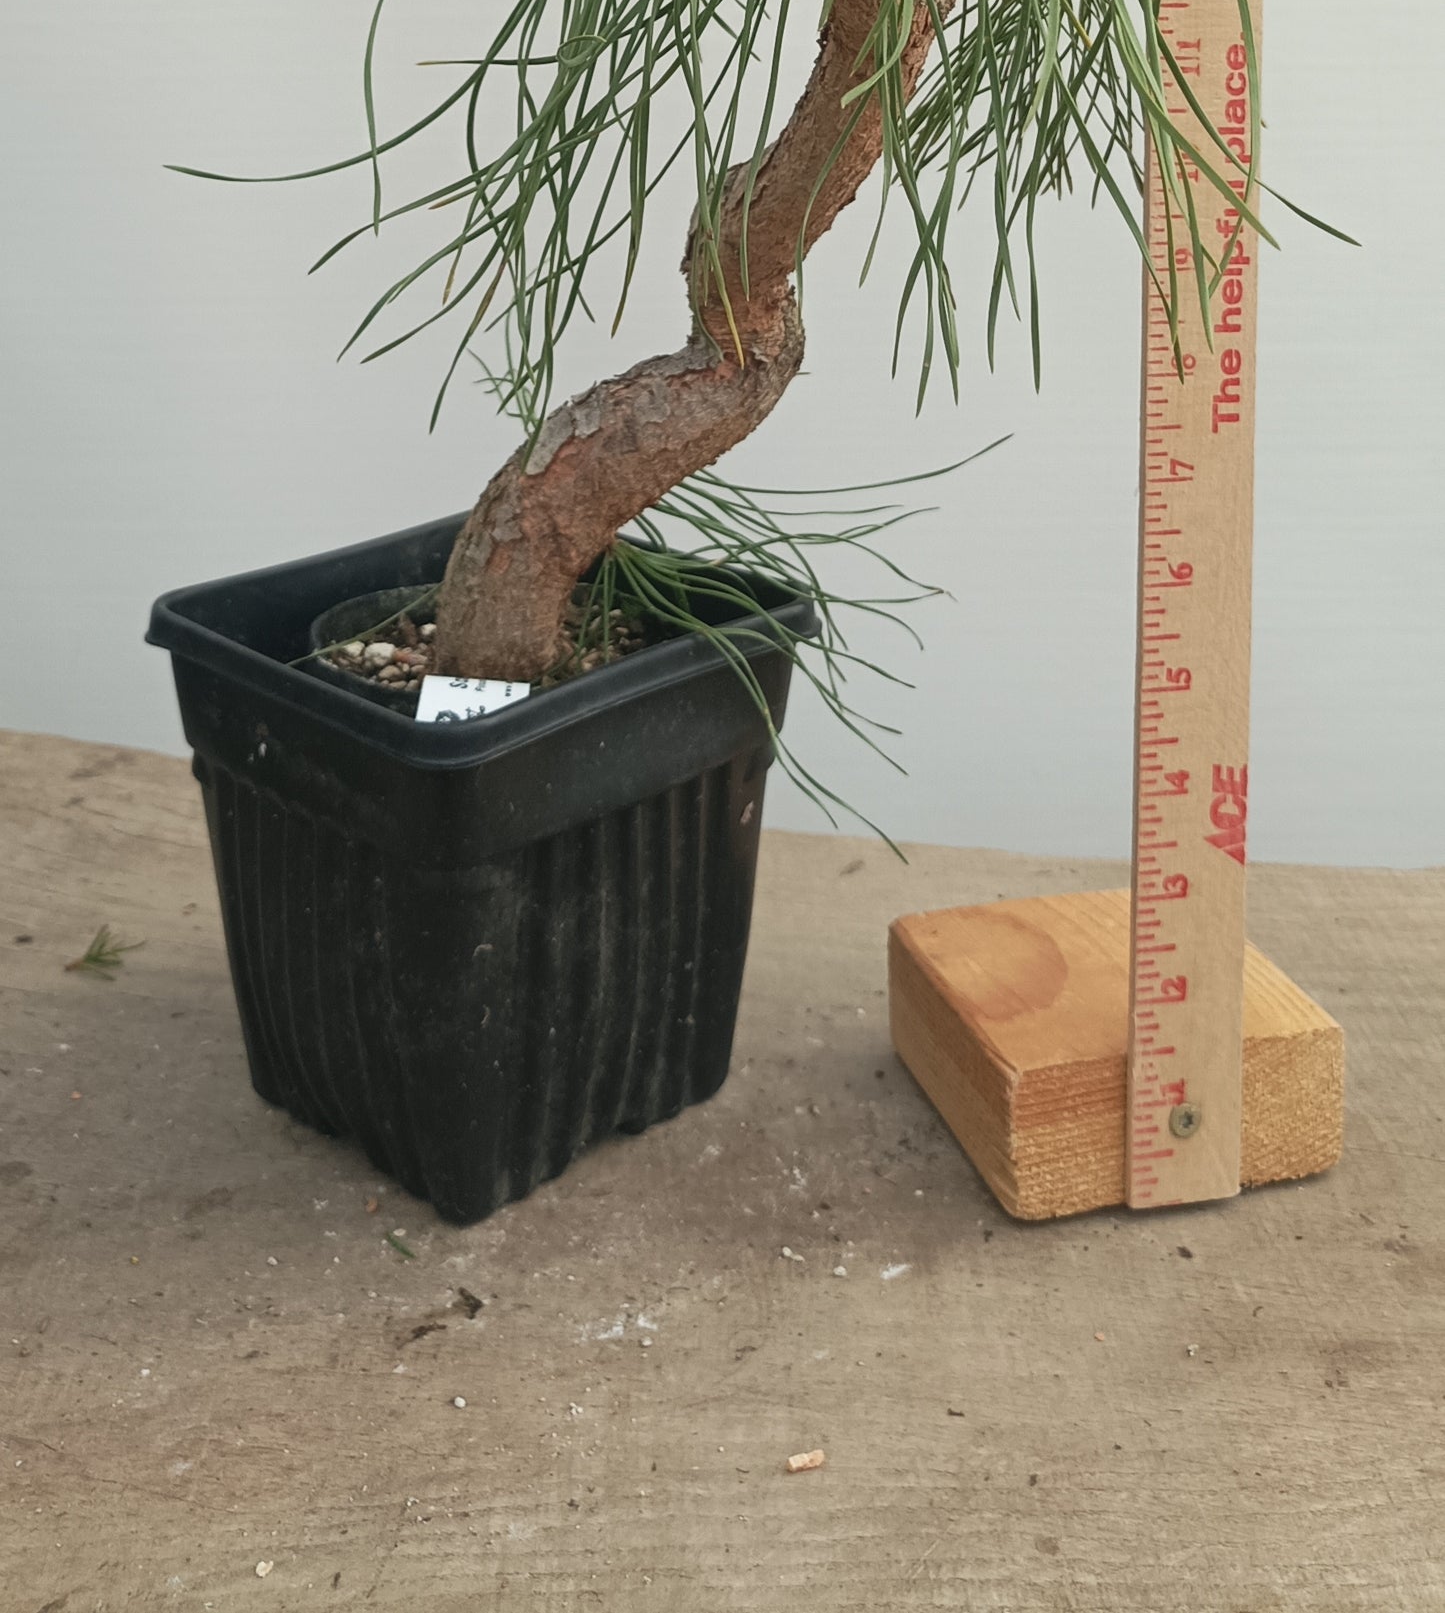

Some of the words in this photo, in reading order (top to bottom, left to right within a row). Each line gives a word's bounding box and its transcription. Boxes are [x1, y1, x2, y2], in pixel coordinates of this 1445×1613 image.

[1211, 348, 1242, 434] The
[1169, 458, 1195, 477] 7
[1168, 561, 1194, 580] 6
[1166, 666, 1192, 687] 5
[1164, 769, 1190, 790] 4
[1203, 764, 1248, 867] ACE
[1162, 873, 1188, 897] 3
[1161, 975, 1187, 1000] 2
